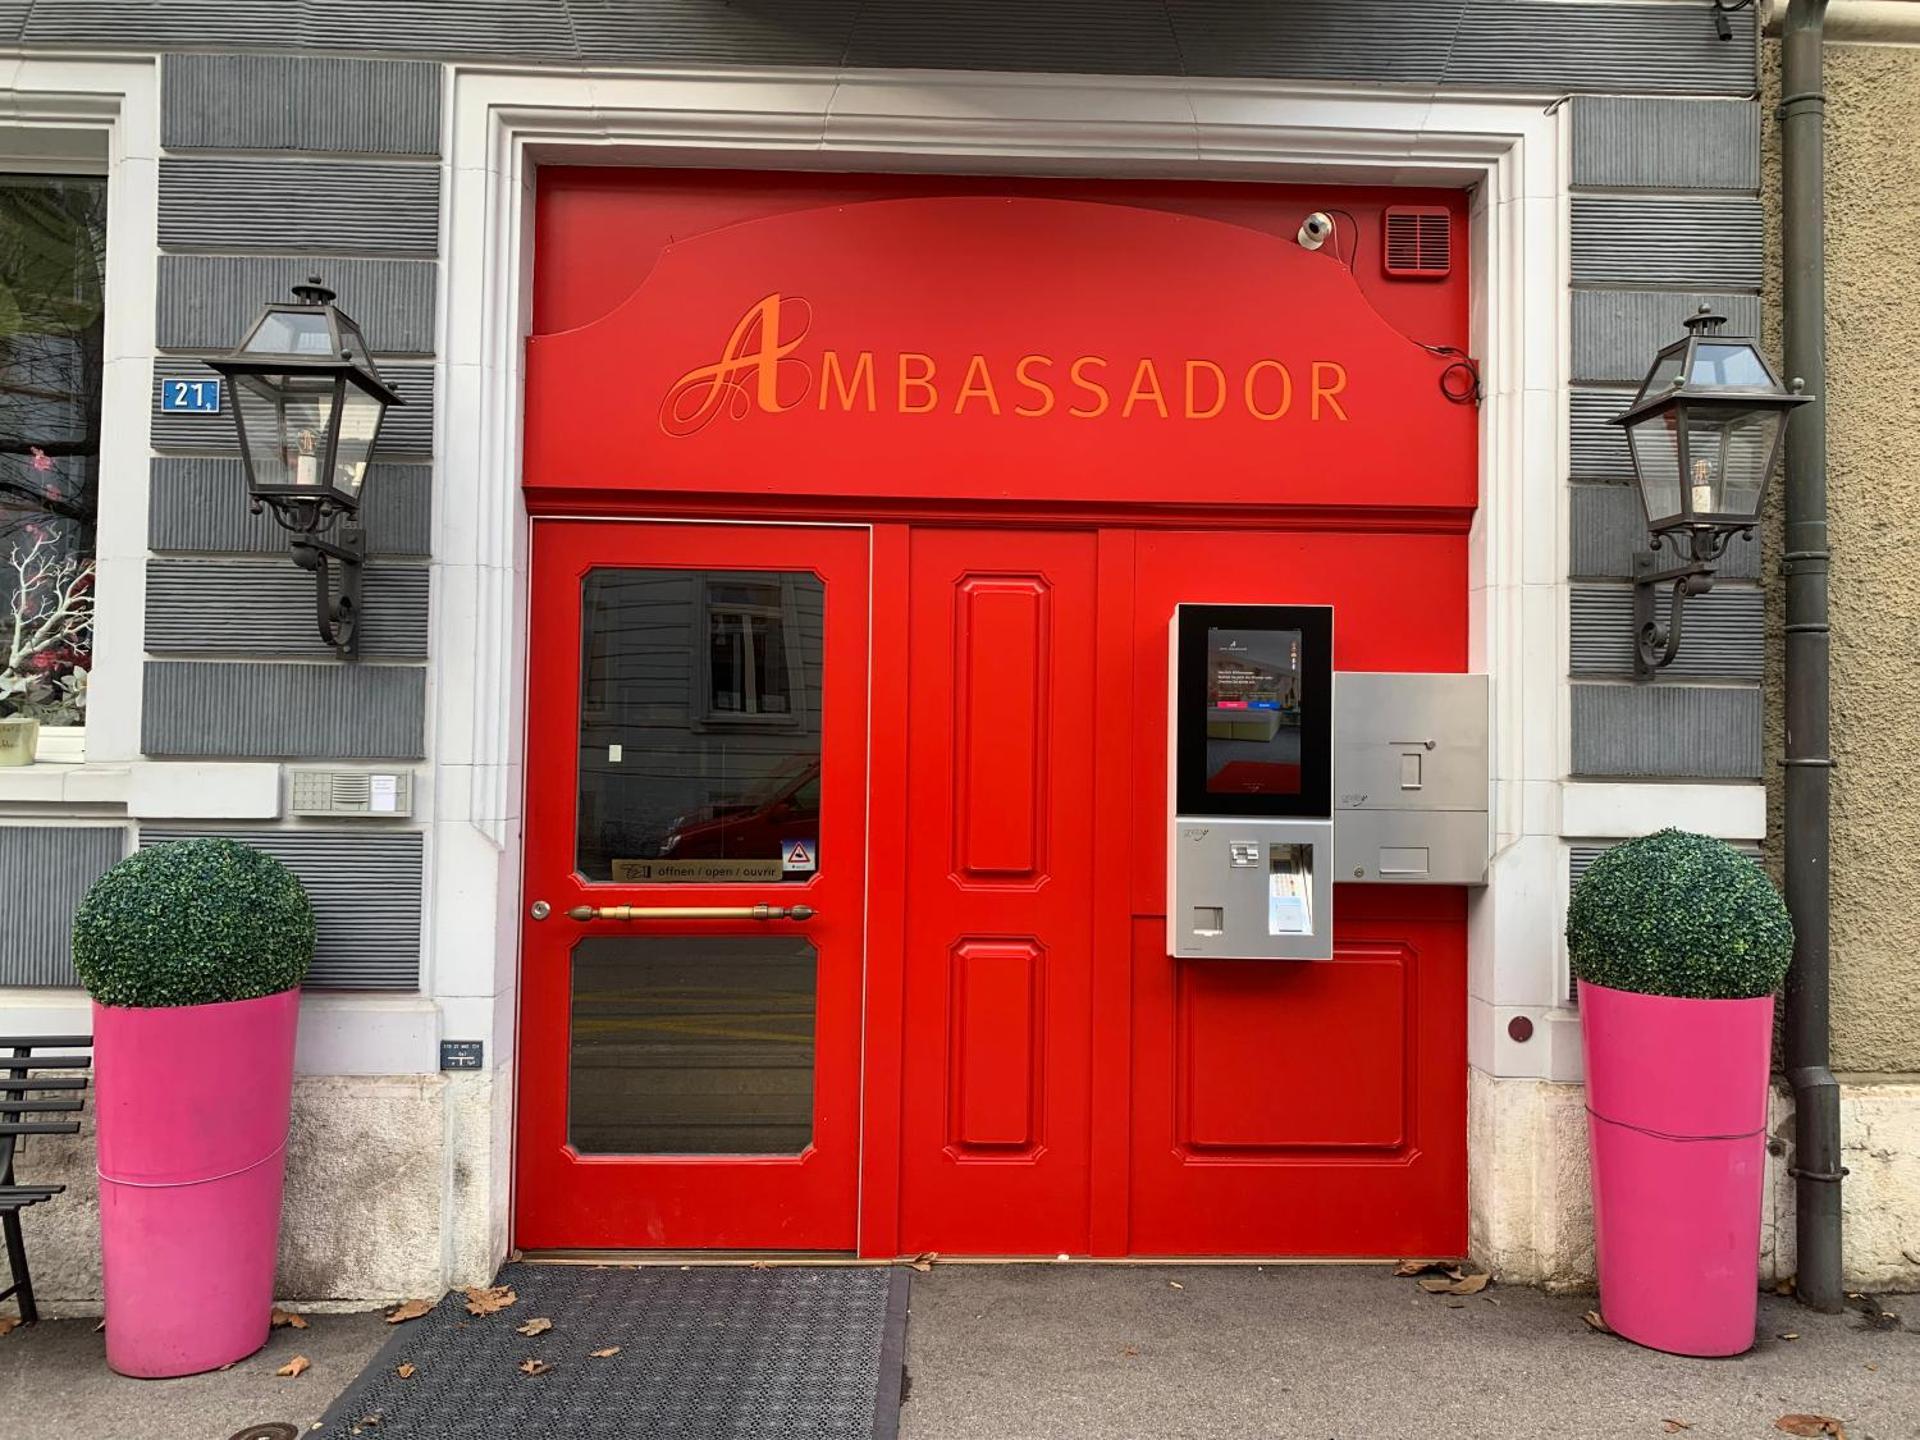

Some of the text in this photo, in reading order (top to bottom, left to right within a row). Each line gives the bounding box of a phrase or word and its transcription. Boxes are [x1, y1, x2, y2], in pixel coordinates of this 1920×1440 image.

[658, 292, 1349, 438] AMBASSADOR
[174, 382, 203, 407] 21
[704, 867, 733, 879] open
[742, 866, 776, 877] ouvrir
